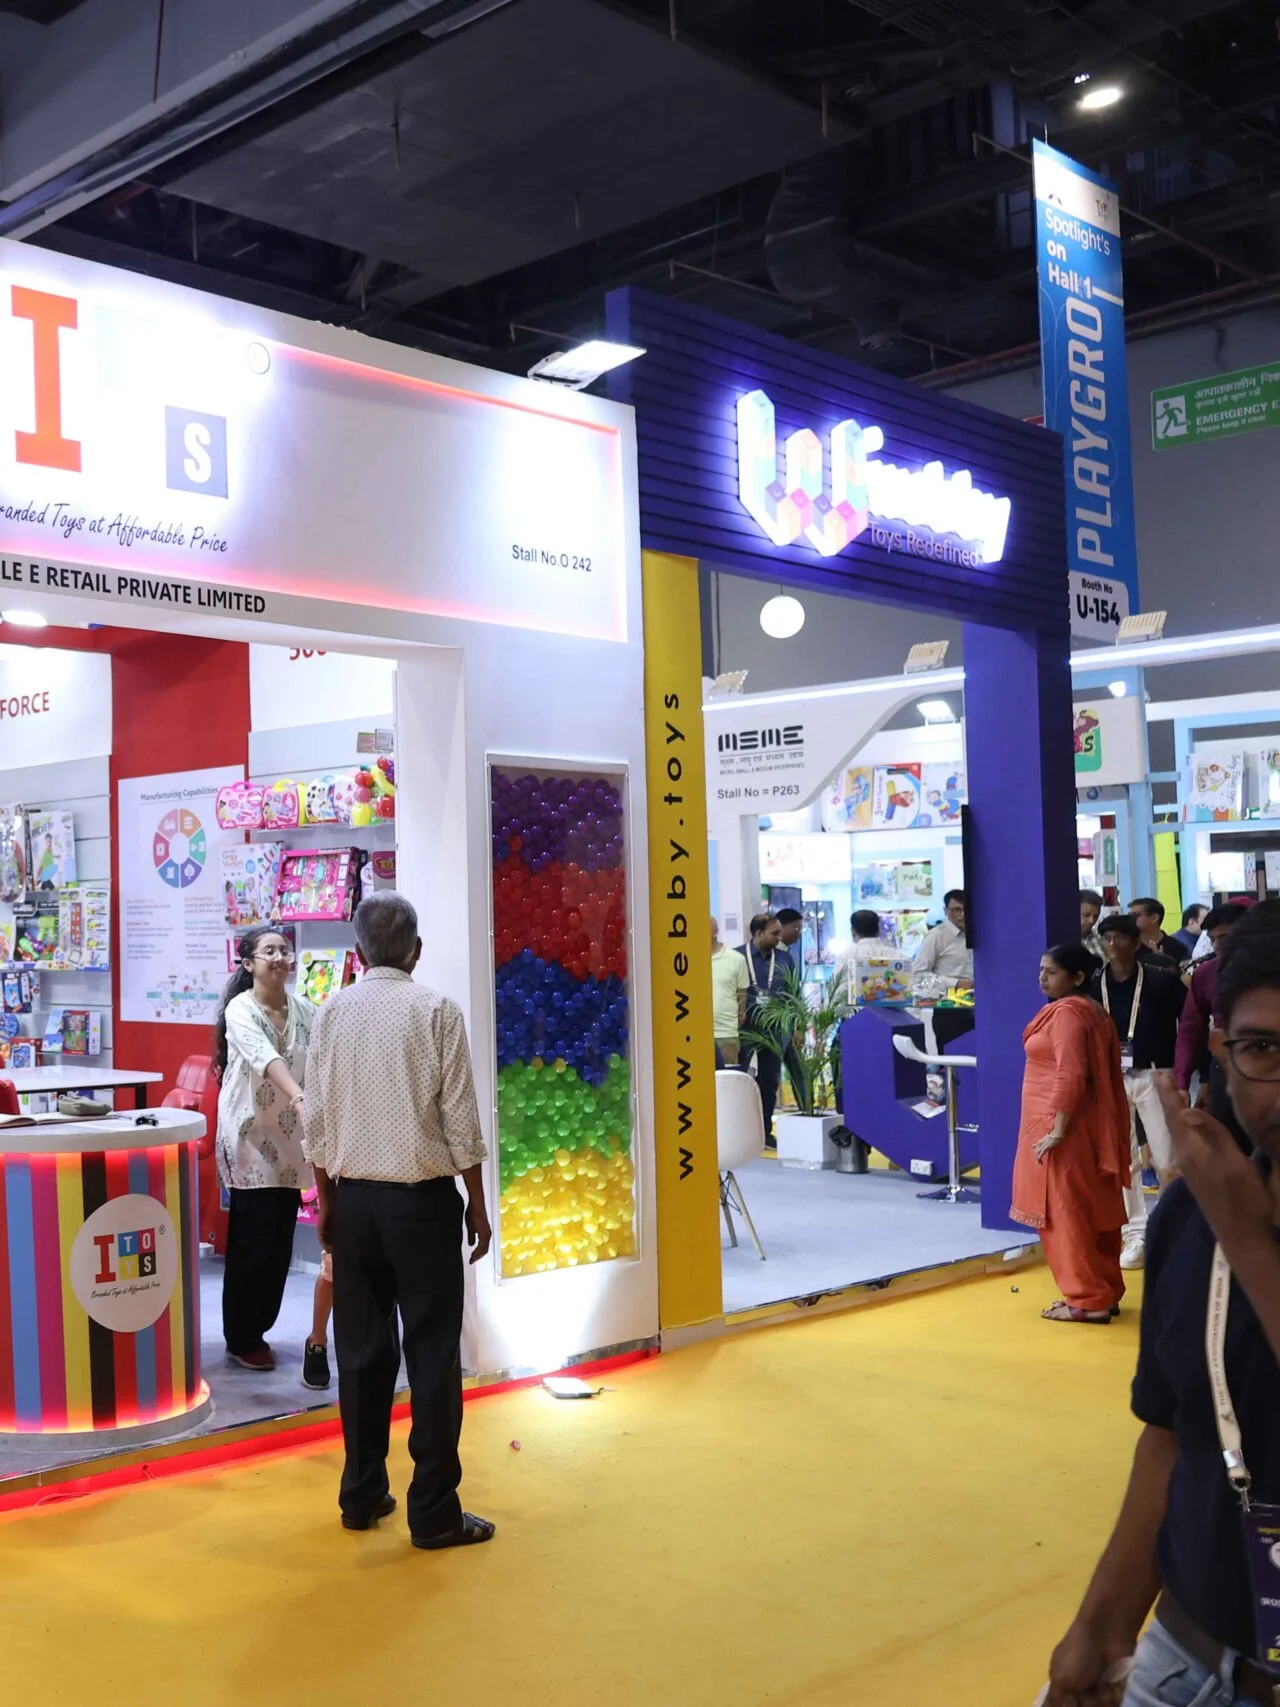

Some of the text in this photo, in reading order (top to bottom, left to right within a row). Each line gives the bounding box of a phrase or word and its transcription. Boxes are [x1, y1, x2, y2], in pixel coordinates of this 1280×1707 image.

[1045, 208, 1111, 256] Spotlight's
[1046, 239, 1067, 262] on
[1048, 261, 1092, 299] Hall 1
[11, 284, 81, 473] I
[1066, 296, 1114, 567] PLAYGRO
[1196, 402, 1268, 426] EMERGENCY
[51, 503, 86, 539] Toys
[89, 515, 105, 533] at
[107, 512, 186, 547] Affordable
[189, 526, 228, 553] Price
[868, 520, 979, 568] Toys Redefined
[512, 544, 537, 562] Stall
[572, 555, 592, 572] 242
[30, 564, 40, 584] E
[46, 566, 112, 594] RETAIL
[117, 576, 192, 605] PRIVATE
[198, 587, 266, 614] LIMITED
[1081, 577, 1113, 595] Booth No
[1076, 593, 1120, 626] U-154
[141, 786, 218, 800] Manufacturing Capabilities
[718, 788, 741, 799] Stall
[744, 787, 759, 797] No
[772, 785, 800, 796] P263
[663, 693, 694, 1181] www.webby.toys
[94, 1234, 116, 1283] I
[1215, 1277, 1223, 1298] INDIA
